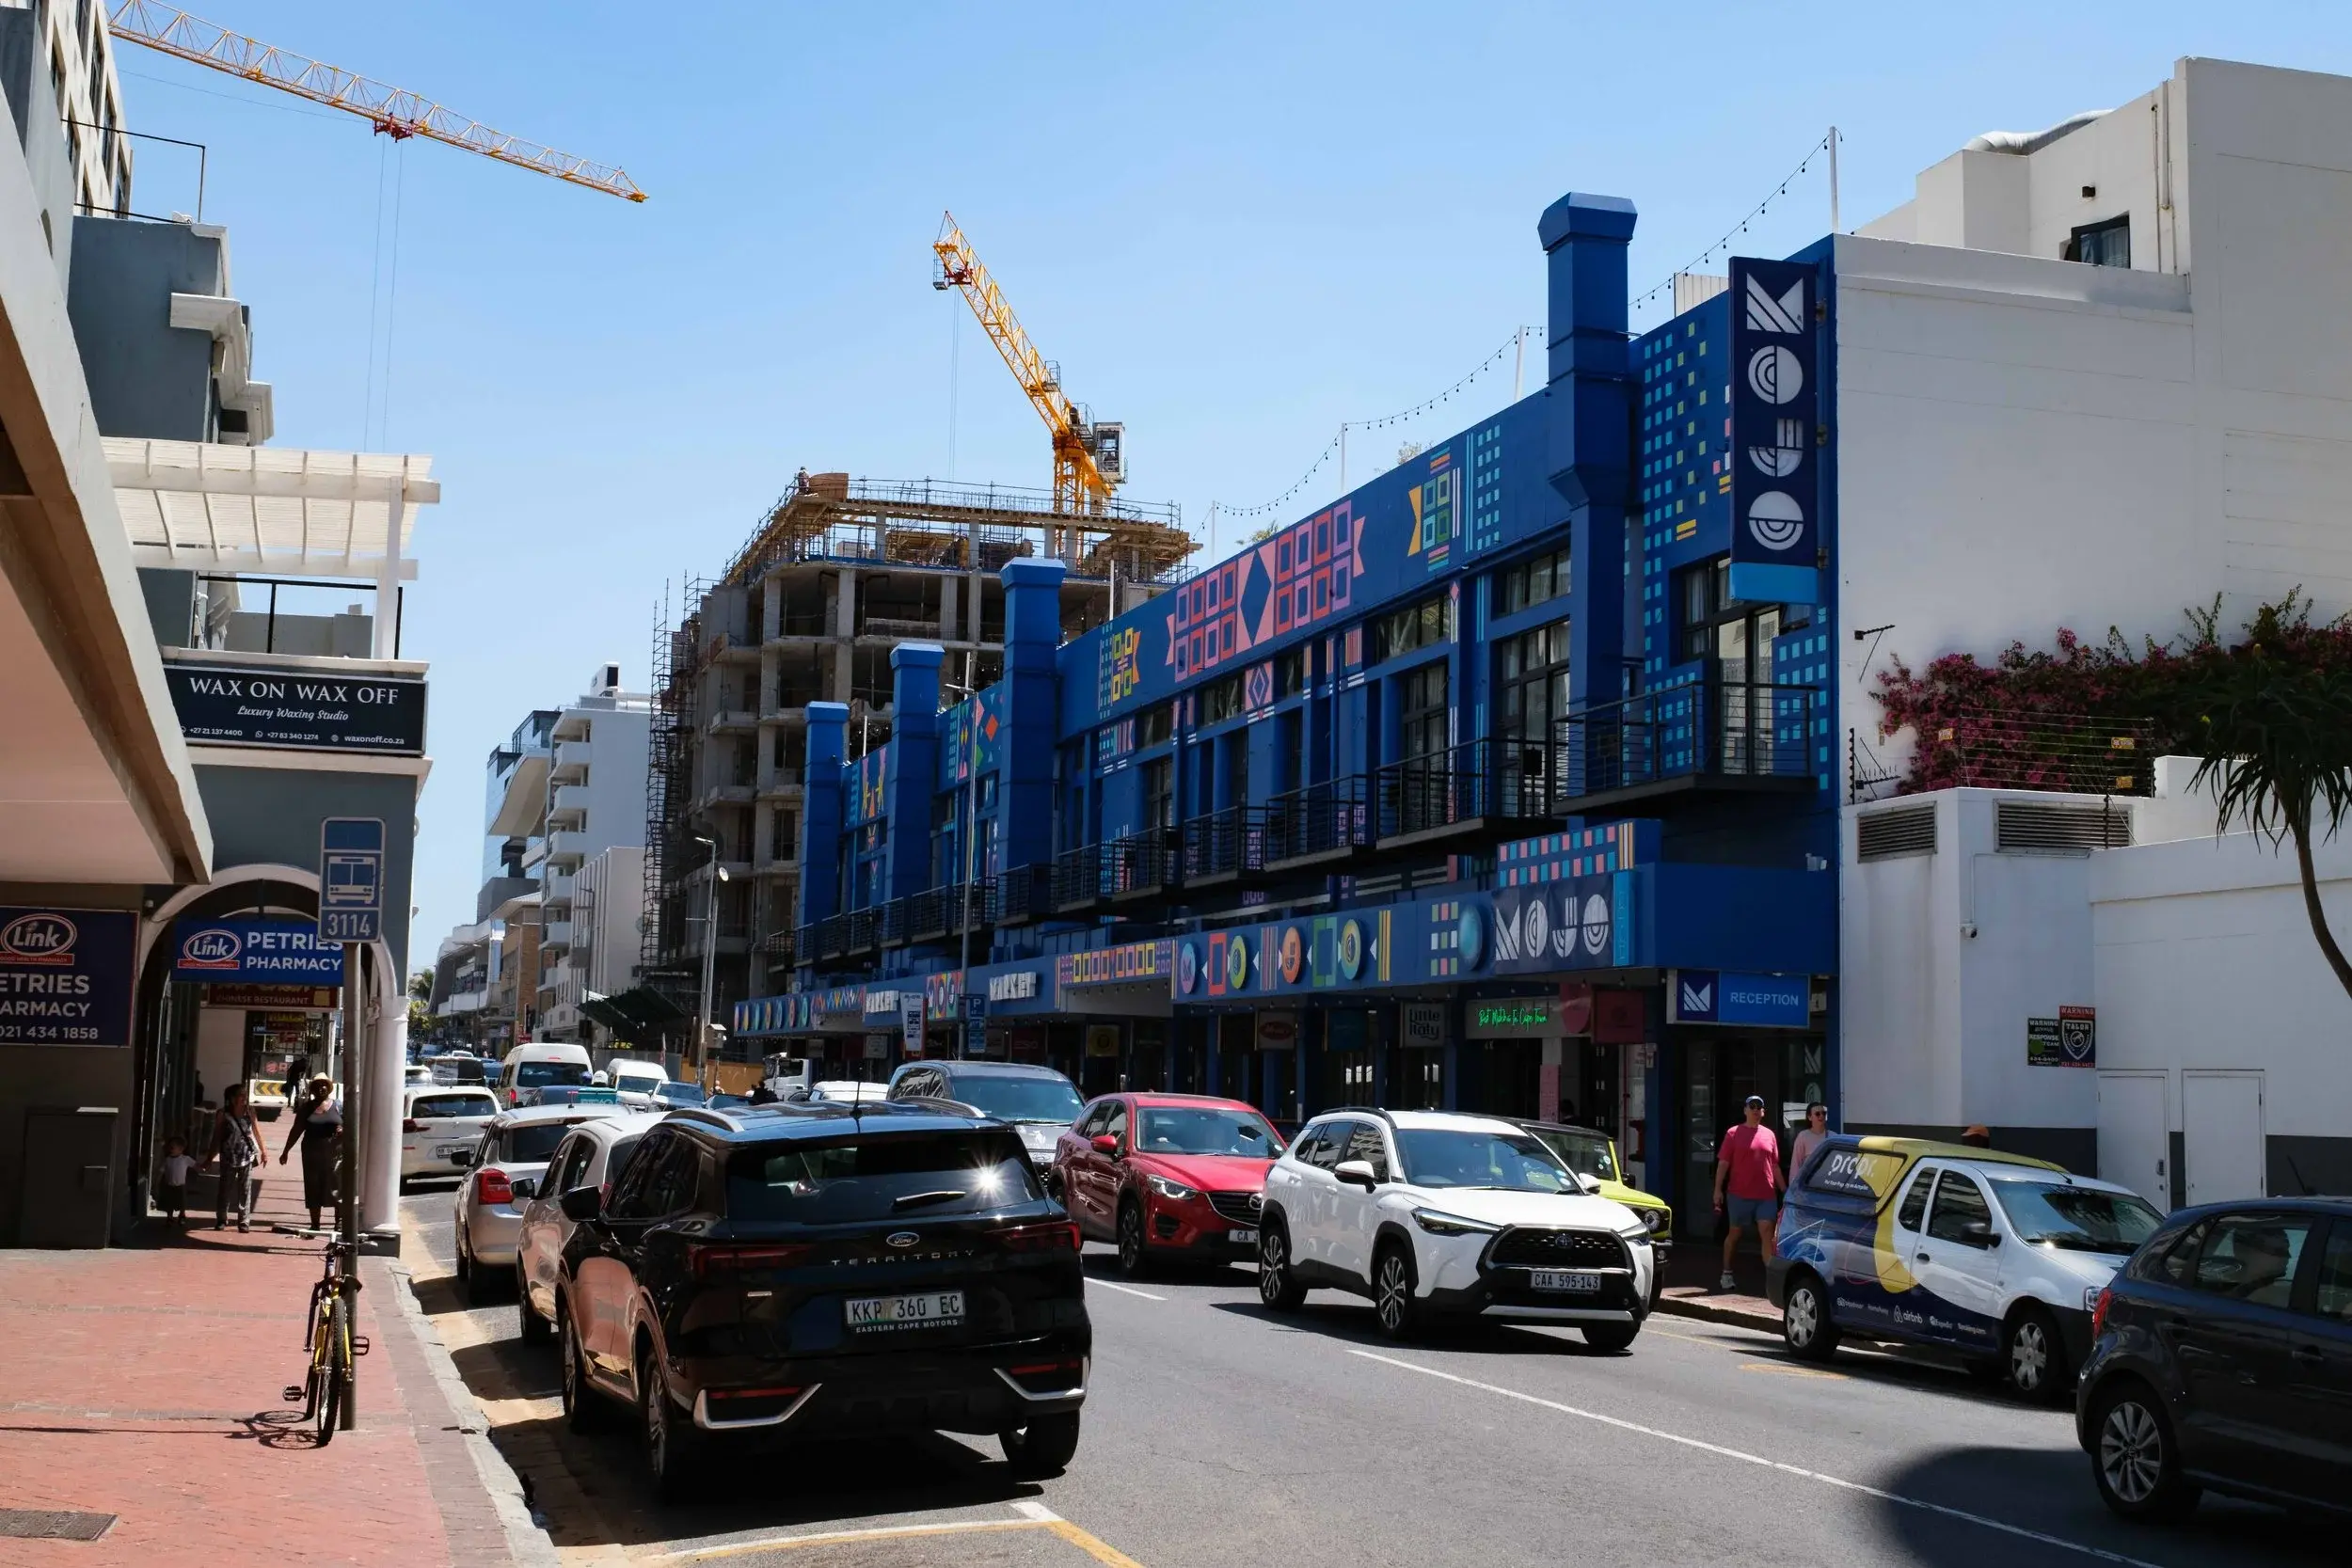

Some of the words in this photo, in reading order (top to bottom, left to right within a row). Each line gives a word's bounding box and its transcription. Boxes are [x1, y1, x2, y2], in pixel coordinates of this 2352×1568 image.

[1746, 272, 1804, 550] MOJO
[189, 677, 243, 697] WAX
[249, 681, 285, 699] ON
[296, 684, 348, 703] WAX
[357, 687, 399, 705] OFF
[237, 705, 274, 719] Luxury
[277, 708, 314, 721] Waxing
[317, 710, 349, 721] Studio
[344, 735, 405, 745] waxonoff.co.za
[327, 913, 371, 937] 3114
[1495, 894, 1610, 960] MOJO
[13, 922, 60, 947] Link
[193, 936, 229, 957] Link
[246, 957, 342, 971] PHARMACY
[254, 995, 309, 1005] RESTAURANT
[1729, 991, 1799, 1006] RECEPTION
[1409, 1008, 1439, 1024] Little
[26, 1026, 57, 1037] 434
[63, 1027, 99, 1039] 1858
[1411, 1023, 1439, 1039] Italy
[831, 1250, 974, 1266] TERRITORY
[1534, 1274, 1552, 1287] CAA
[852, 1301, 882, 1322] KKP
[897, 1298, 927, 1318] 360
[940, 1295, 960, 1314] EC
[1903, 1311, 1923, 1324] airbnb
[856, 1323, 894, 1333] EASTERN
[898, 1322, 919, 1330] CAPE
[923, 1319, 958, 1328] MOTORS
